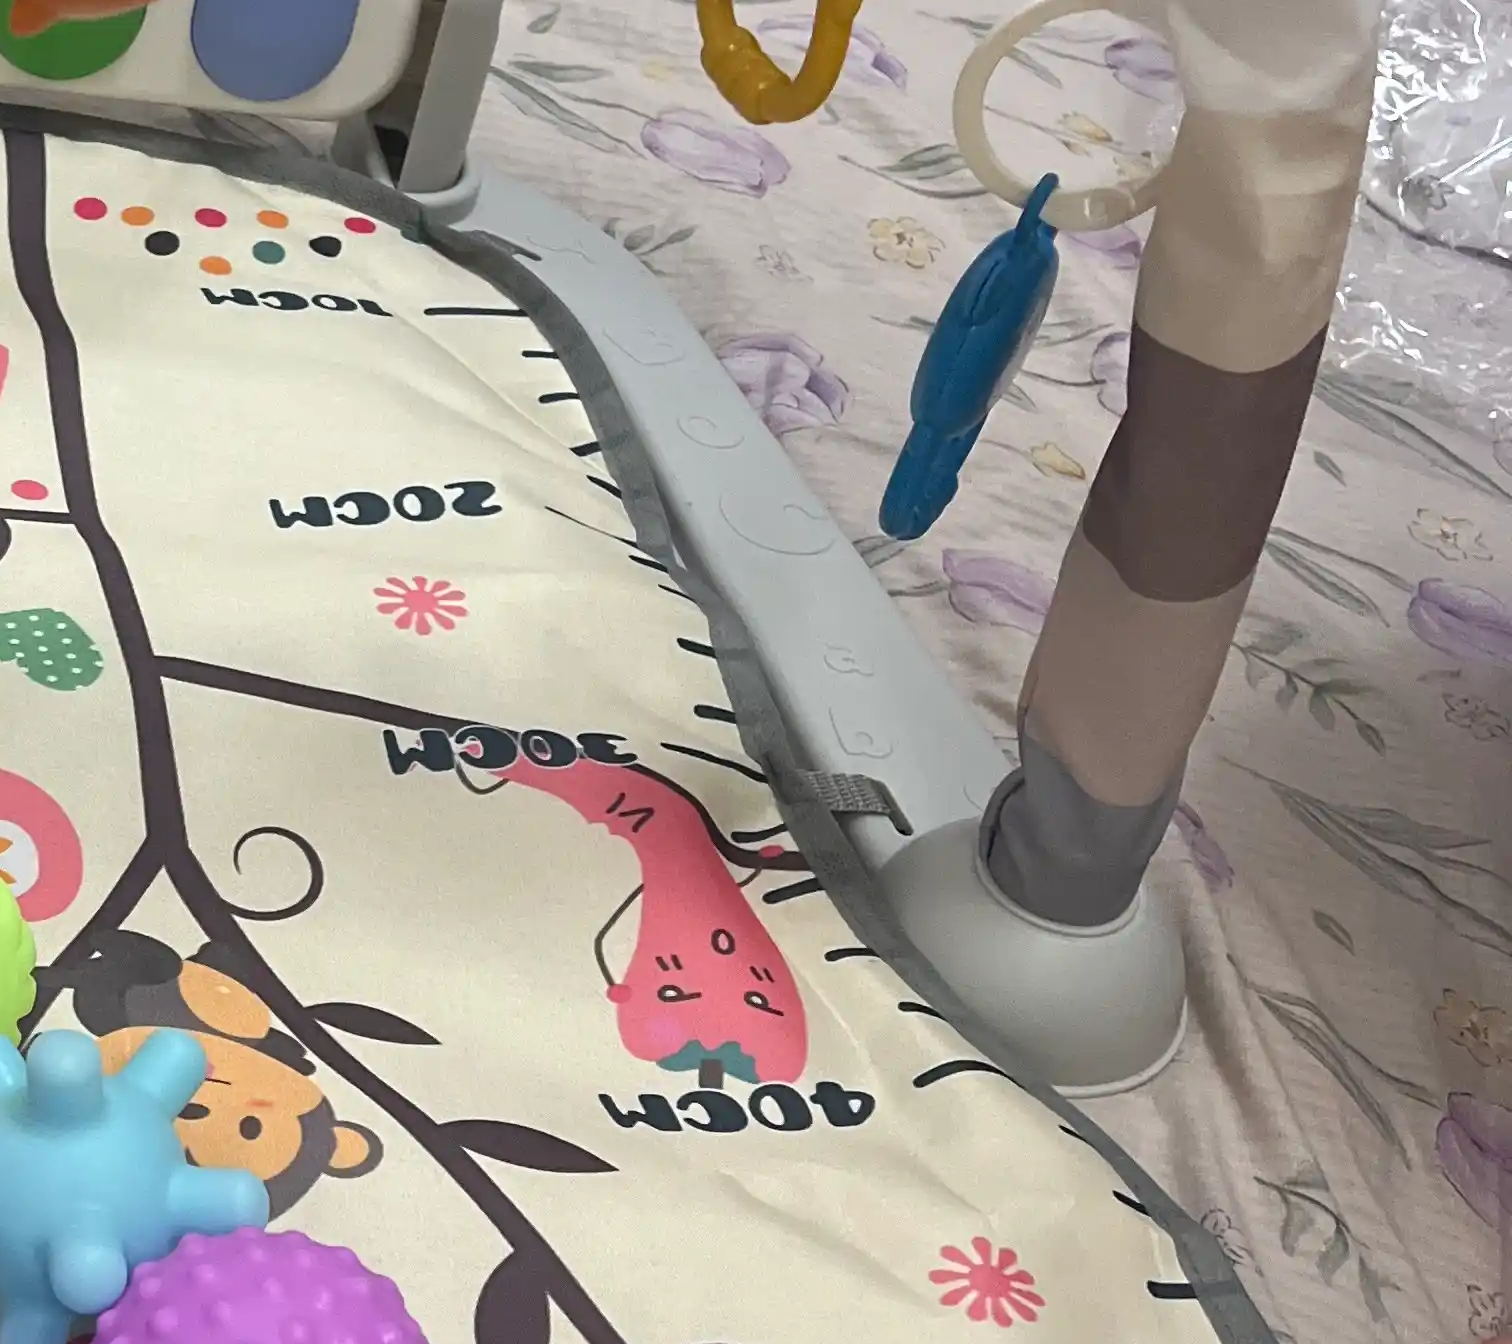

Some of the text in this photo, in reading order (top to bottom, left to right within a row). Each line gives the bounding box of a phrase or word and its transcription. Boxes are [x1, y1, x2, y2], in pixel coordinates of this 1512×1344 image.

[200, 286, 393, 318] 10CM
[268, 481, 503, 530] 20CM
[383, 727, 638, 776] 30CM
[598, 1081, 876, 1133] 40CM
